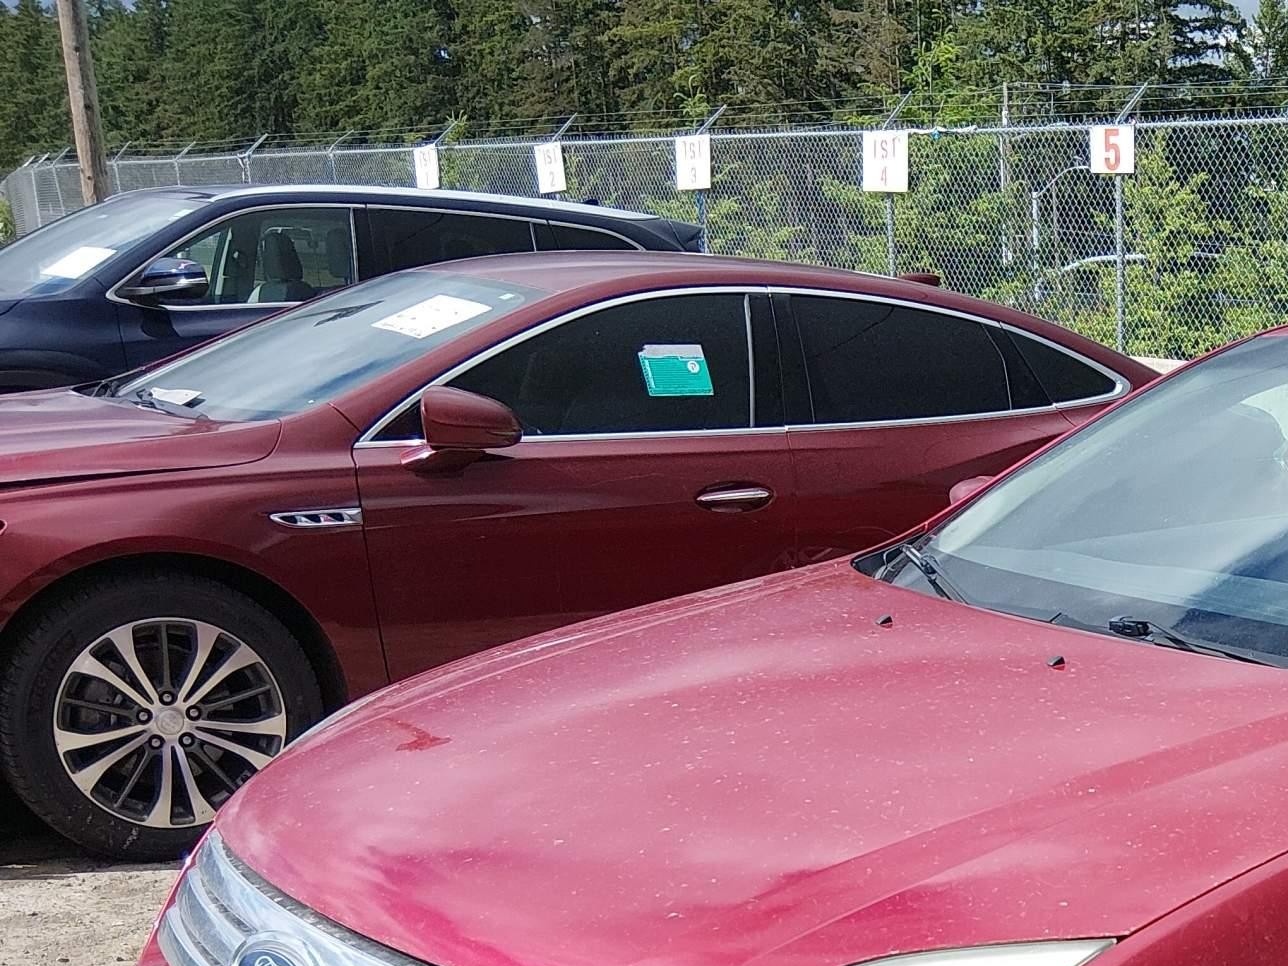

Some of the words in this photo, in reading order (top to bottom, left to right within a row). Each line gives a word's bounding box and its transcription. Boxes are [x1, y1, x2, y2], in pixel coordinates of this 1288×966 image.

[1104, 128, 1120, 171] 5
[550, 171, 557, 188] 2
[690, 167, 697, 184] 3
[880, 165, 888, 187] 4
